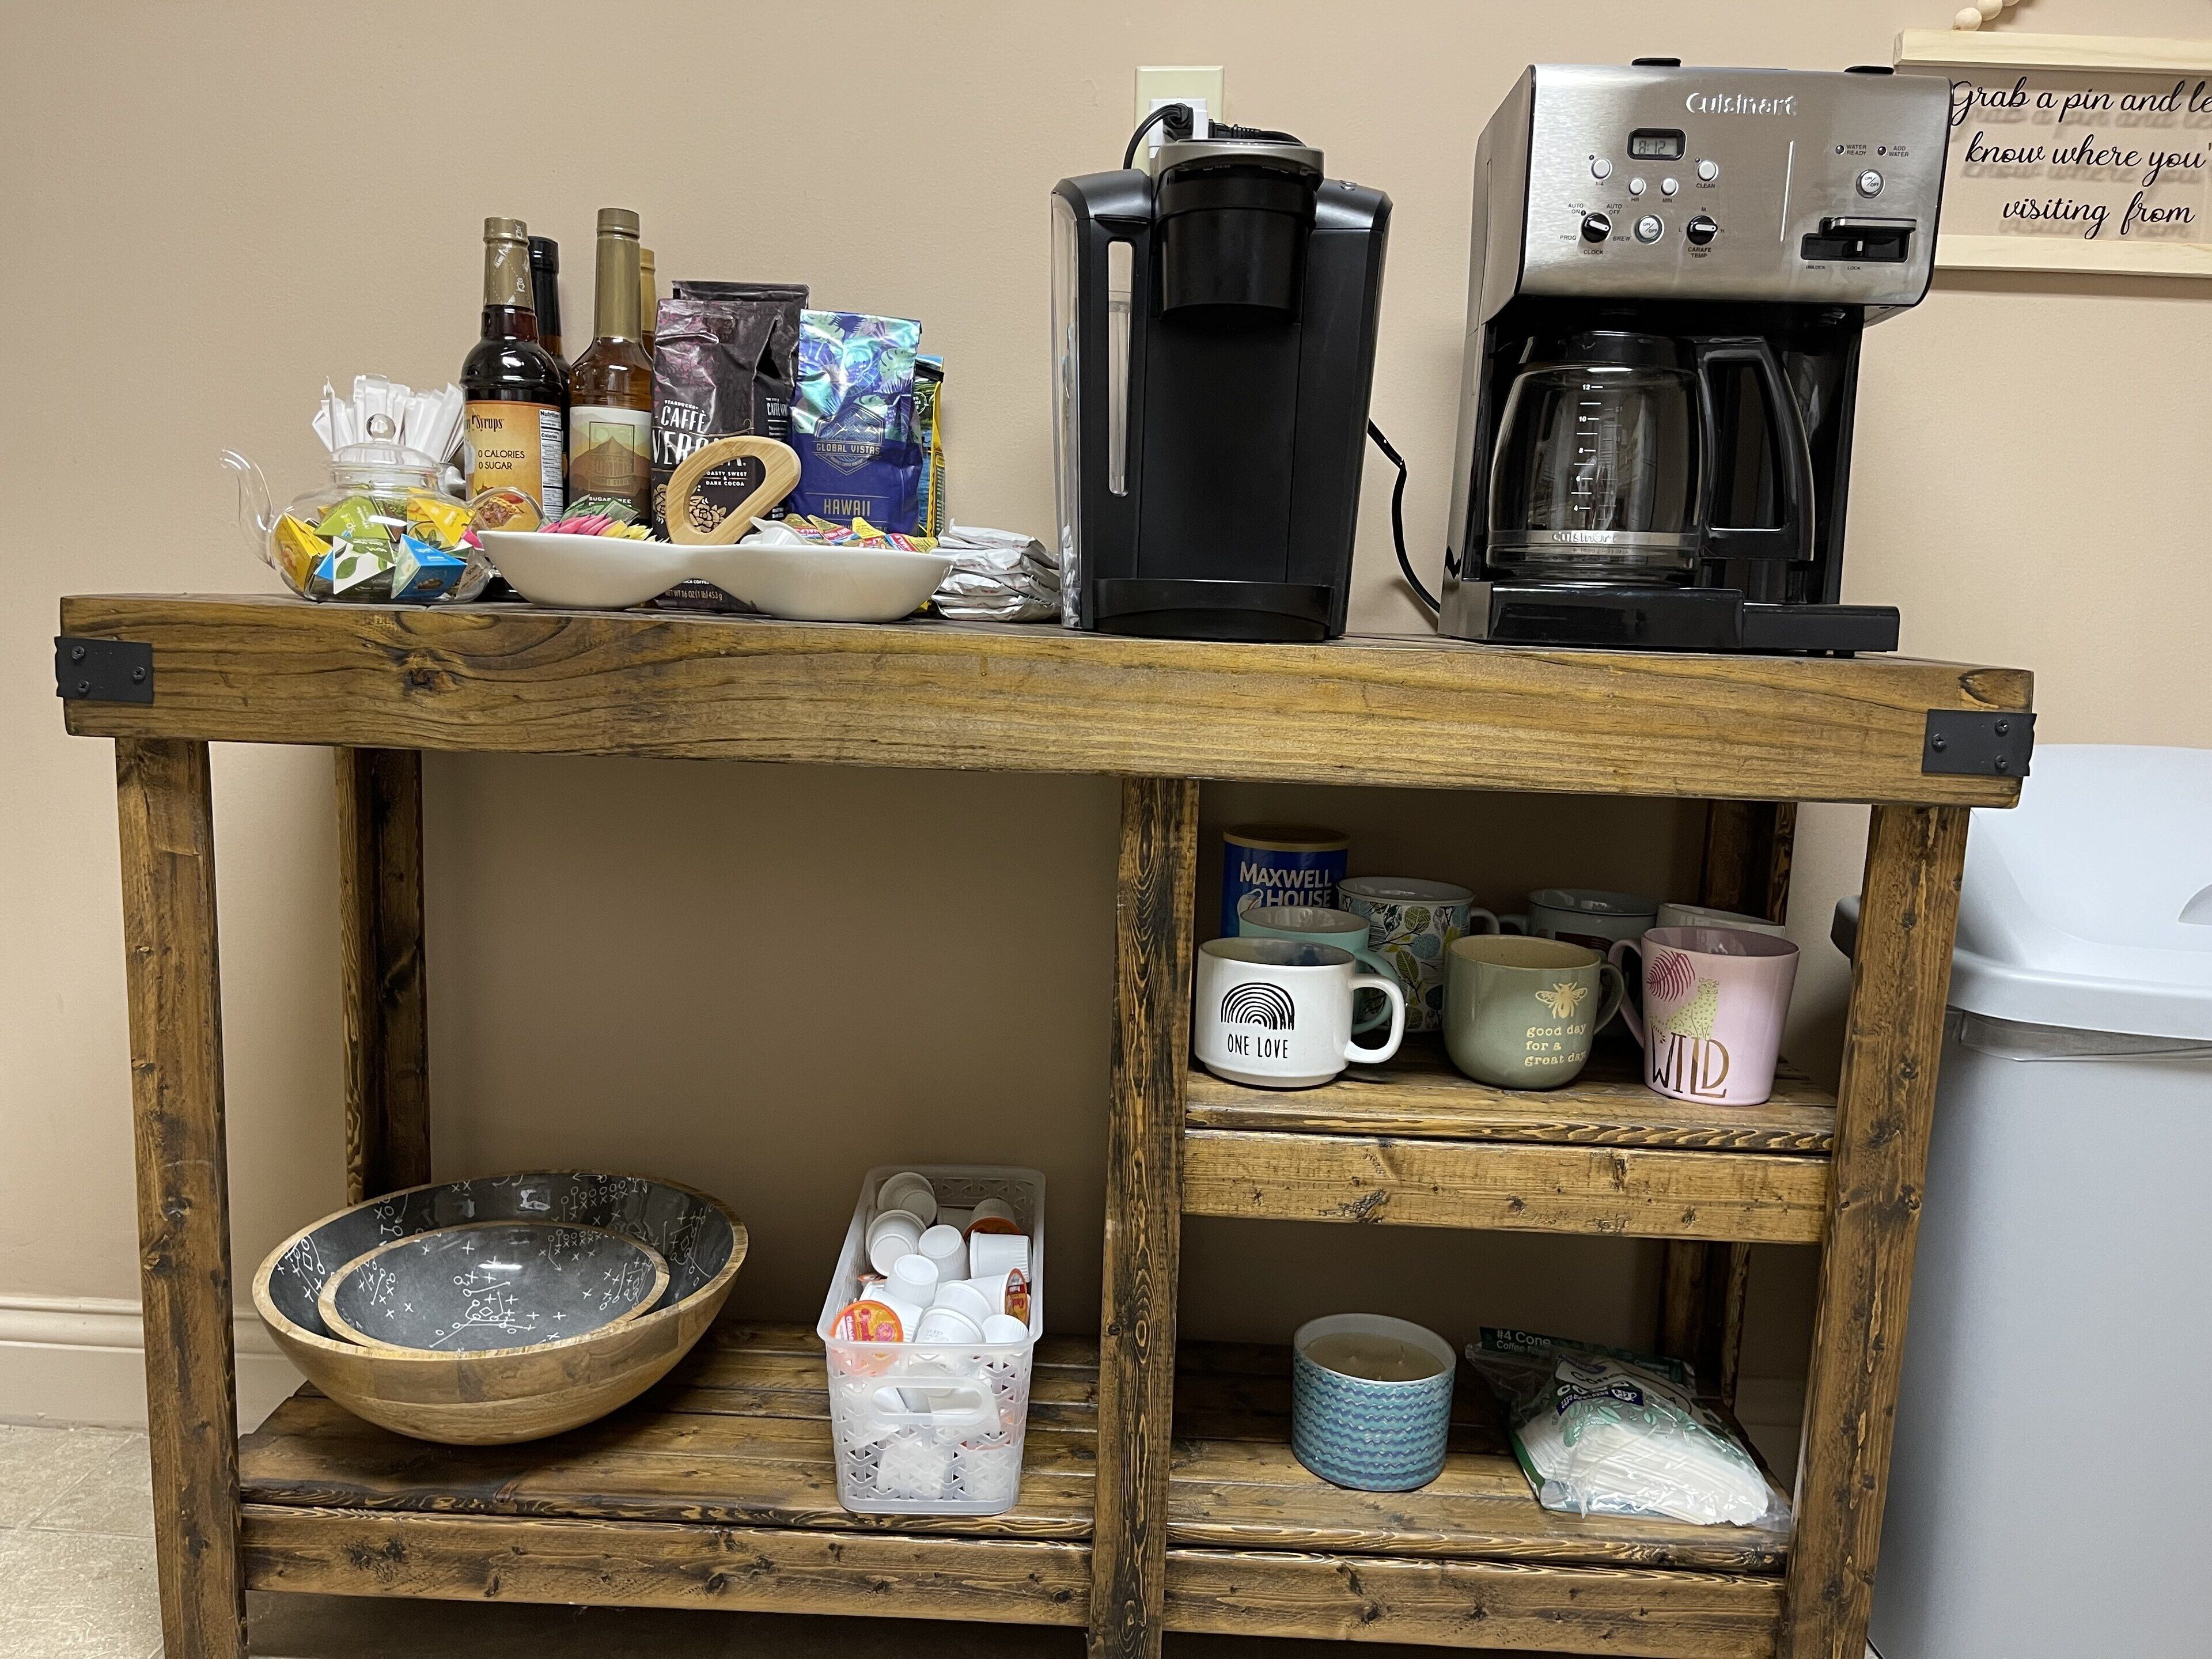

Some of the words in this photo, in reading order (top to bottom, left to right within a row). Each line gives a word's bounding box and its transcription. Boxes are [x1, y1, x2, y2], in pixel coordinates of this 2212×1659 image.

[1685, 92, 1797, 116] Cuisinart
[1951, 77, 2029, 126] Grab
[2036, 92, 2058, 109] a
[2058, 89, 2115, 123] pin
[2120, 79, 2185, 112] and
[2188, 81, 2212, 113] le
[1638, 140, 1666, 154] 8:12
[1965, 131, 2046, 163] know
[2052, 134, 2142, 166] where
[2142, 142, 2212, 187] you'
[2002, 198, 2110, 240] visiting
[2120, 191, 2196, 235] from
[476, 414, 503, 432] Syrups
[661, 405, 707, 433] CAFFÈ
[478, 449, 483, 457] 0
[484, 449, 525, 459] CALORIES
[816, 443, 847, 452] GLOBAL
[851, 445, 881, 455] VISTAS
[479, 461, 483, 469] 0
[485, 461, 513, 470] SUGAR
[824, 498, 871, 517] HAWAII
[688, 590, 695, 599] OZ
[1240, 861, 1332, 888] MAXWELL
[1266, 889, 1331, 908] HOUSE
[1527, 1026, 1562, 1038] good
[1566, 1024, 1586, 1035] day
[1228, 1033, 1249, 1056] ONE
[1257, 1037, 1289, 1059] LOVE
[1526, 1040, 1548, 1051] for
[1553, 1041, 1562, 1051] a
[1524, 1055, 1565, 1066] great
[1651, 1027, 1729, 1099] WILD
[1497, 1329, 1512, 1341] #4
[1515, 1331, 1551, 1346] Cone
[1497, 1340, 1525, 1353] Coffee
